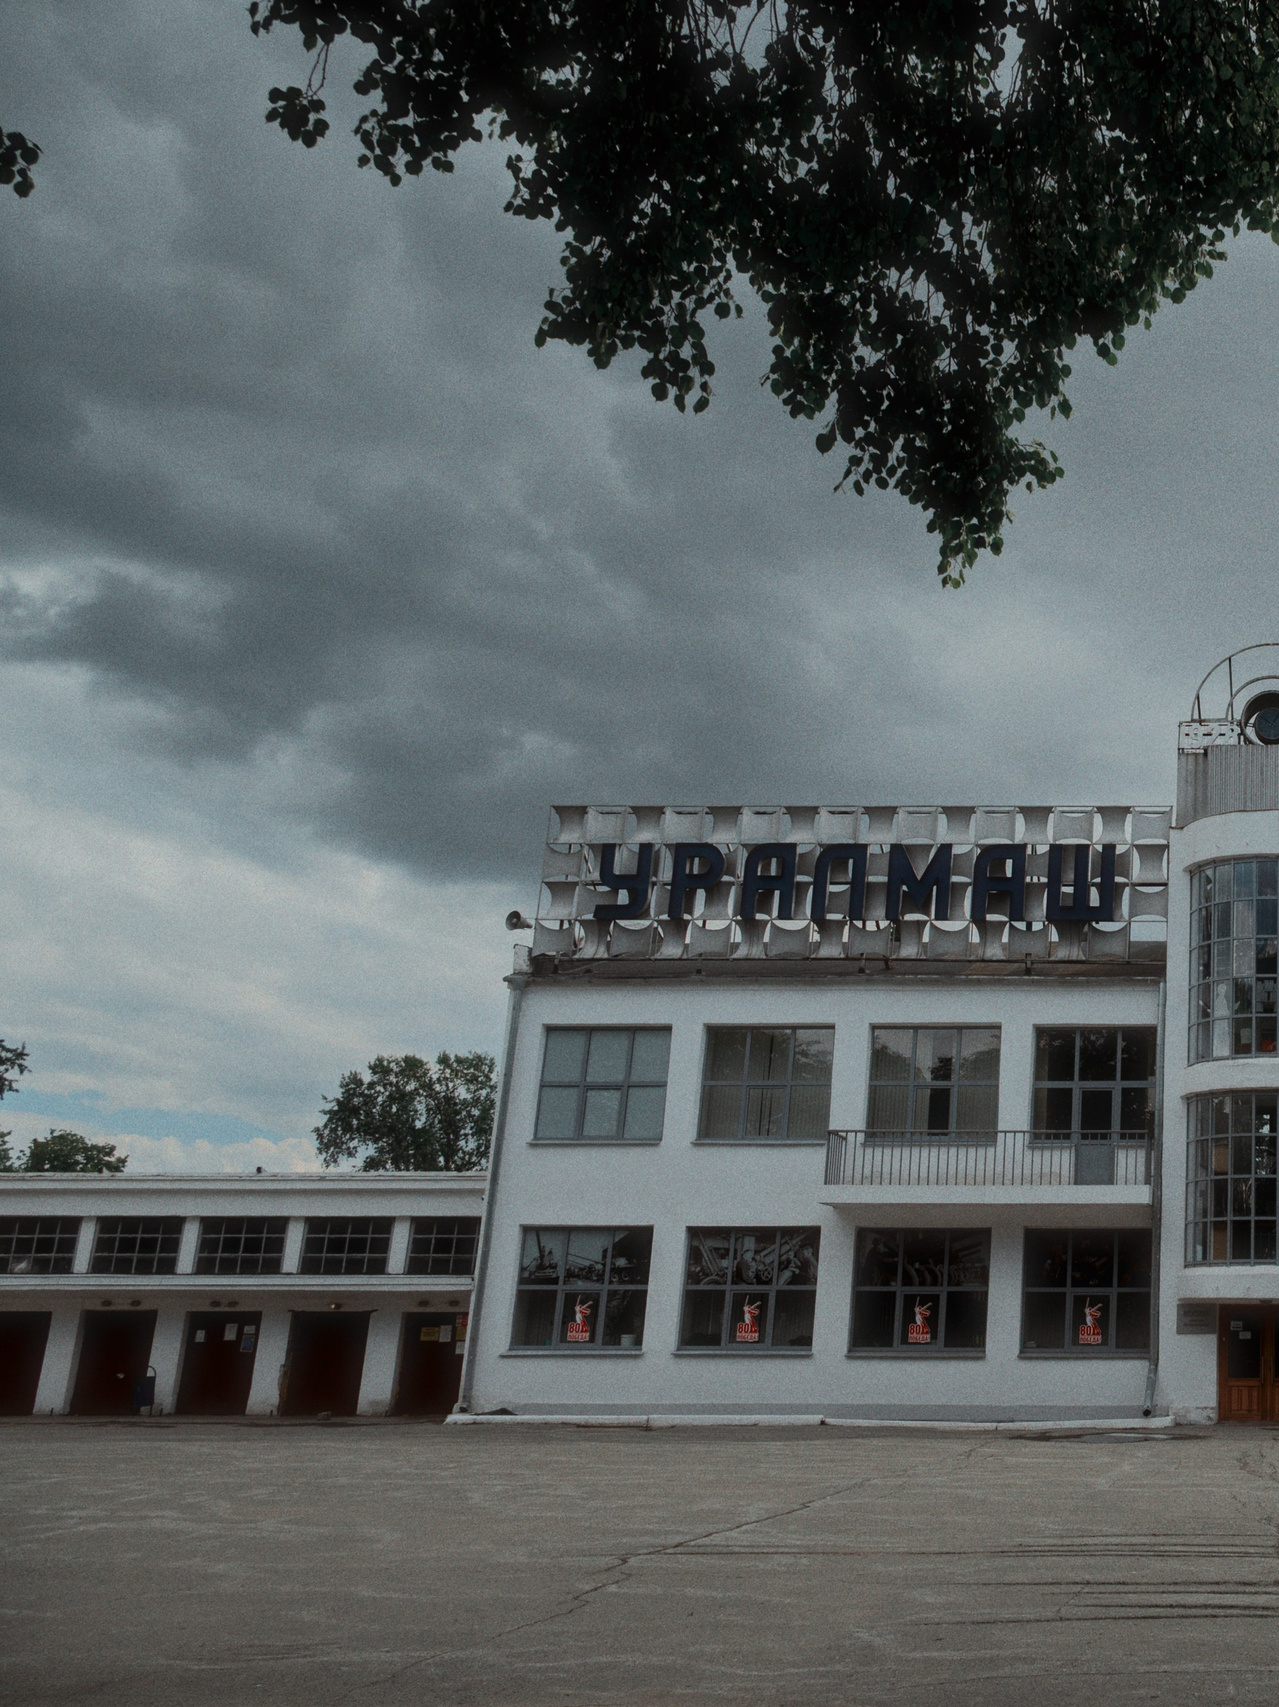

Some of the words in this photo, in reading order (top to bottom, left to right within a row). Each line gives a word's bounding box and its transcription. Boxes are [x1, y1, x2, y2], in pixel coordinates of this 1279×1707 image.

[593, 843, 1114, 922] УРАЛМАШ
[569, 1323, 580, 1333] 80
[738, 1323, 749, 1333] 80
[910, 1325, 920, 1334] 80
[1080, 1326, 1091, 1335] 80
